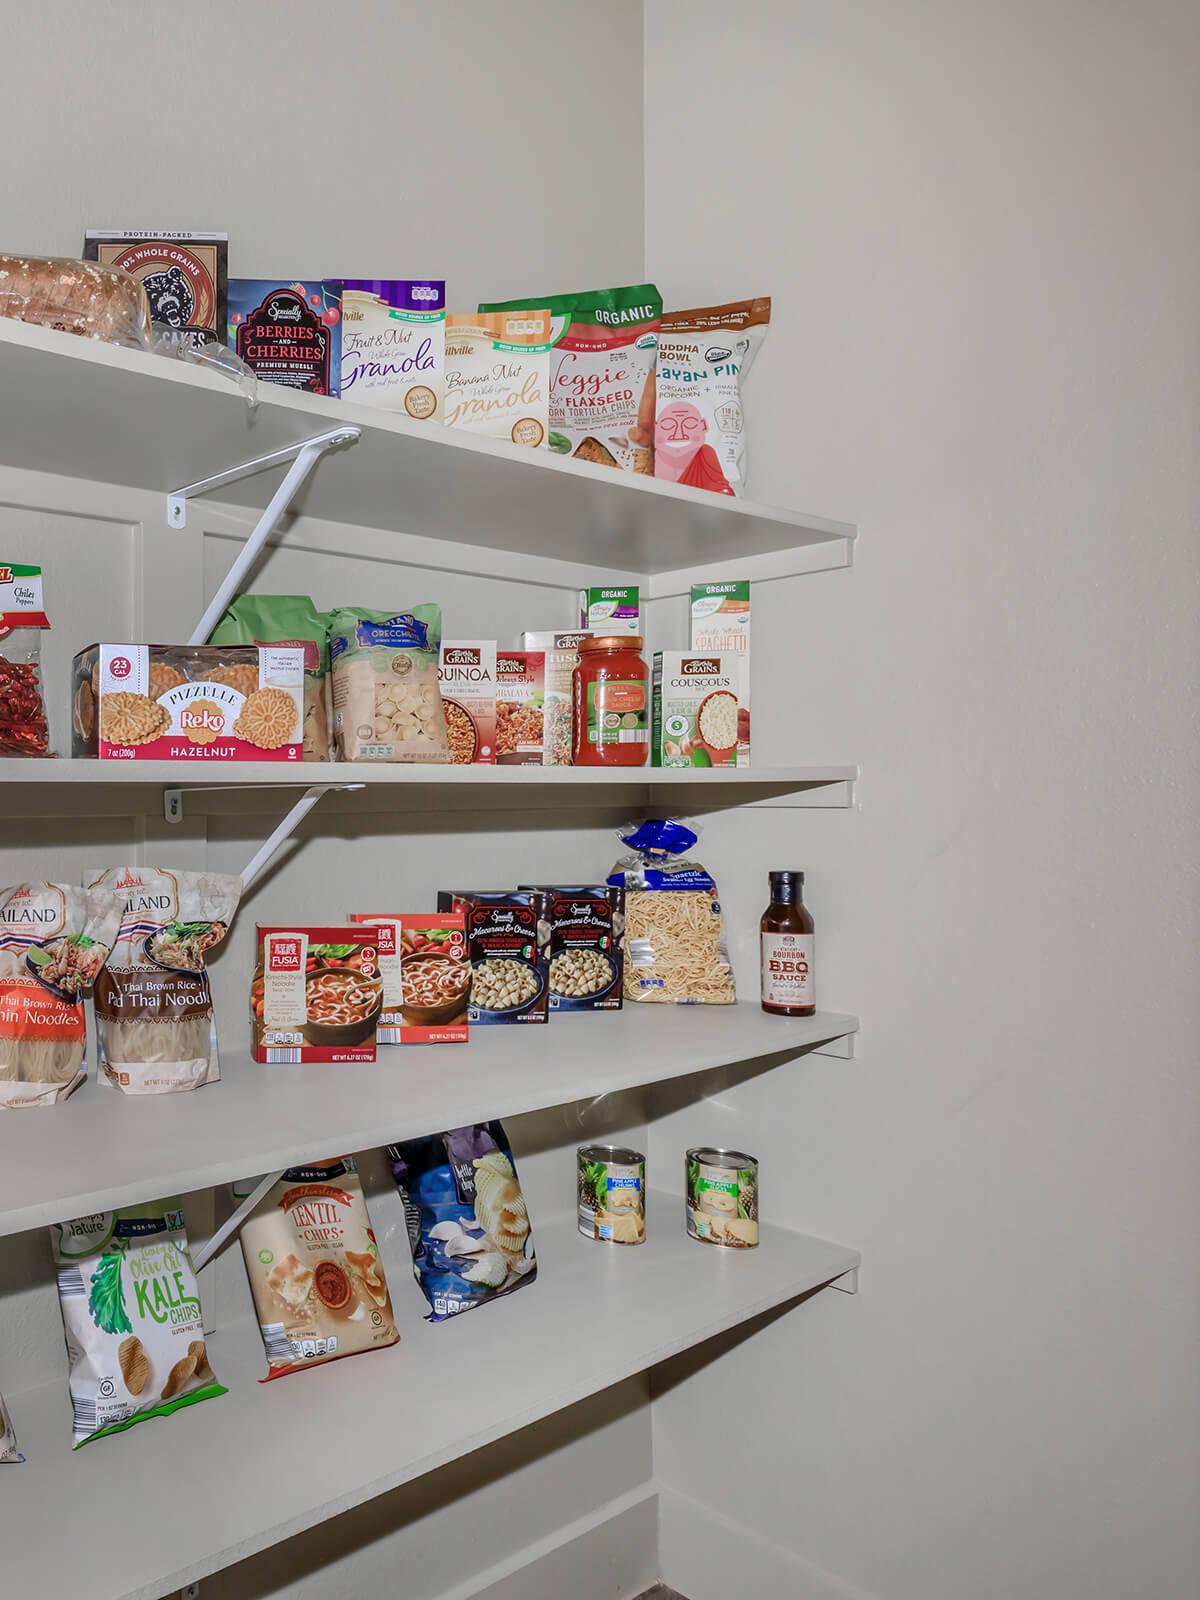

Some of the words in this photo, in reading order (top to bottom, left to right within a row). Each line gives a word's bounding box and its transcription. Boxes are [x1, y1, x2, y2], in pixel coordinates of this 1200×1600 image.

[135, 248, 169, 259] WHOLE
[170, 249, 200, 276] GRAINS
[268, 302, 302, 321] Specially
[595, 305, 654, 325] ORGANIC
[255, 325, 314, 340] BERRIES
[344, 332, 375, 351] Fruit
[375, 335, 383, 346] &
[384, 327, 412, 346] Nut
[247, 345, 321, 360] CHERRIES
[659, 351, 691, 362] BOWL
[340, 337, 435, 391] Granola
[446, 372, 490, 389] Banana
[493, 363, 522, 381] Nut
[548, 353, 630, 396] Veggie
[658, 391, 701, 399] POPCORN
[660, 384, 699, 392] ORGANIC
[443, 371, 542, 427] Granola
[565, 389, 633, 408] FLAXSEED
[549, 408, 566, 417] ORN
[569, 405, 608, 417] TORTILLA
[611, 400, 637, 412] CHIPS
[13, 587, 35, 599] Chiles
[601, 590, 628, 598] ORGANIC
[706, 584, 737, 594] ORGANIC
[113, 660, 128, 669] 23
[446, 653, 480, 665] GRAINS
[438, 667, 491, 682] QUINOA
[683, 663, 719, 674] GRAINS
[670, 678, 730, 688] COUSCOUS
[169, 685, 239, 707] PIZZELLE
[180, 710, 226, 732] Reko
[107, 749, 112, 757] 7
[118, 748, 136, 759] (200g)
[170, 747, 236, 758] HAZELNUT
[469, 924, 505, 940] Macaroni
[513, 925, 536, 938] Cheese
[271, 956, 299, 967] FUSIA
[772, 950, 806, 959] BOURBON
[768, 959, 809, 974] BBQ
[772, 973, 807, 982] SAUCE
[123, 983, 144, 992] Thai
[146, 981, 175, 992] Brown
[176, 981, 197, 991] Rice
[0, 995, 20, 1006] Thai
[23, 997, 52, 1010] Brown
[107, 991, 124, 1009] Pad
[131, 992, 161, 1008] Thai
[165, 990, 210, 1007] Noodl
[24, 1011, 80, 1026] Noodles
[291, 1201, 342, 1227] LENTIL
[303, 1226, 340, 1241] CHIPS
[133, 1271, 201, 1325] KALE
[170, 1305, 200, 1325] CHIPS
